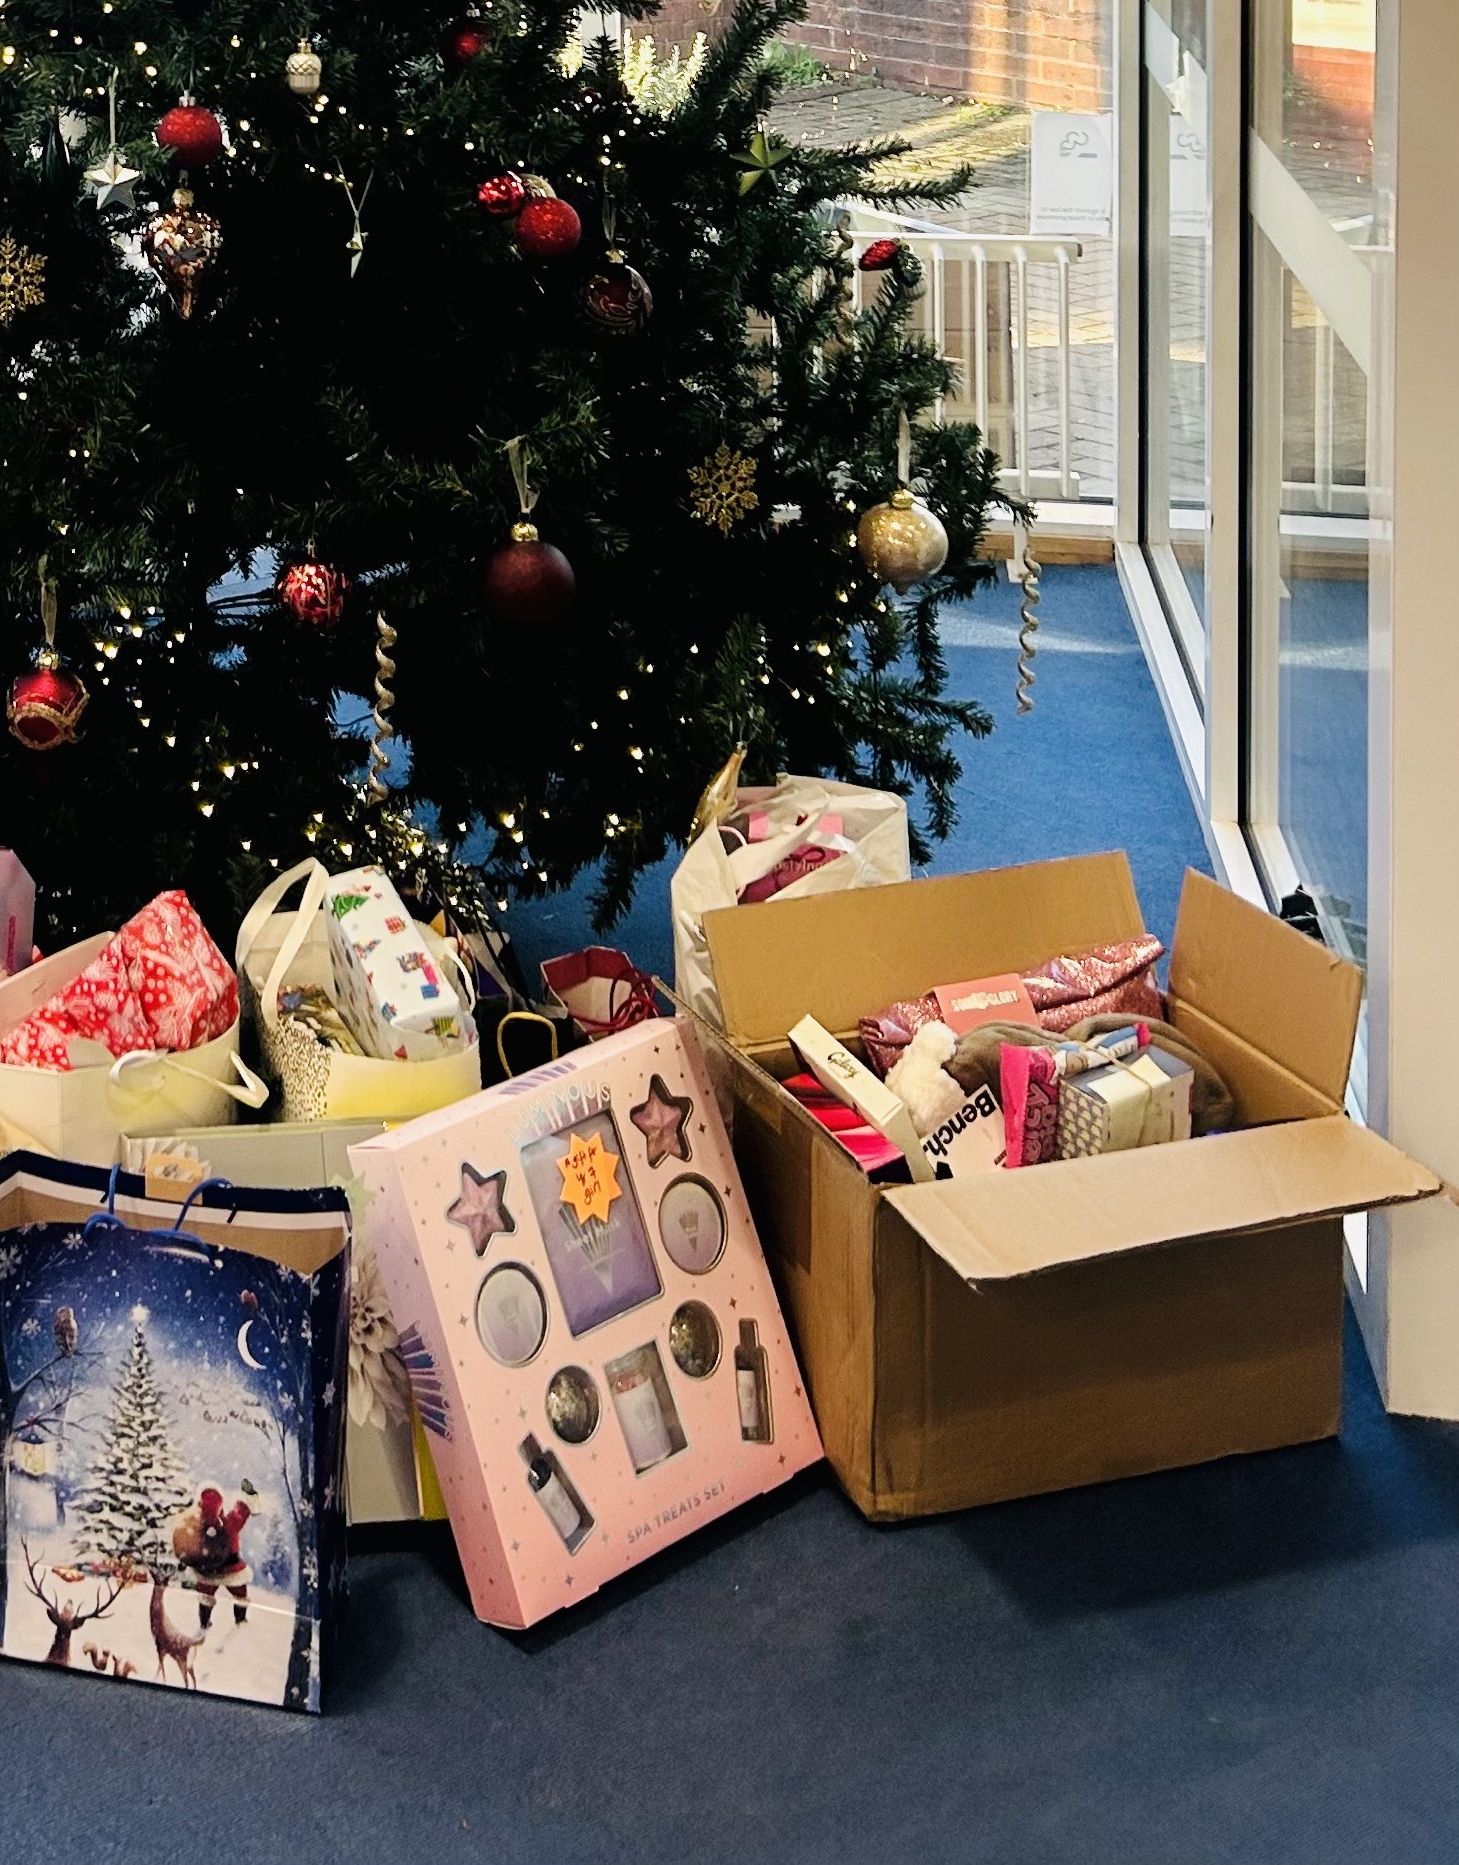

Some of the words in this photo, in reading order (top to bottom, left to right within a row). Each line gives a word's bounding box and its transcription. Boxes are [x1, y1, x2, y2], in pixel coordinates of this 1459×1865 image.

[1022, 1083, 1050, 1162] ercy
[627, 1522, 653, 1544] SPA
[654, 1493, 702, 1528] TREATS
[703, 1479, 726, 1501] SET
